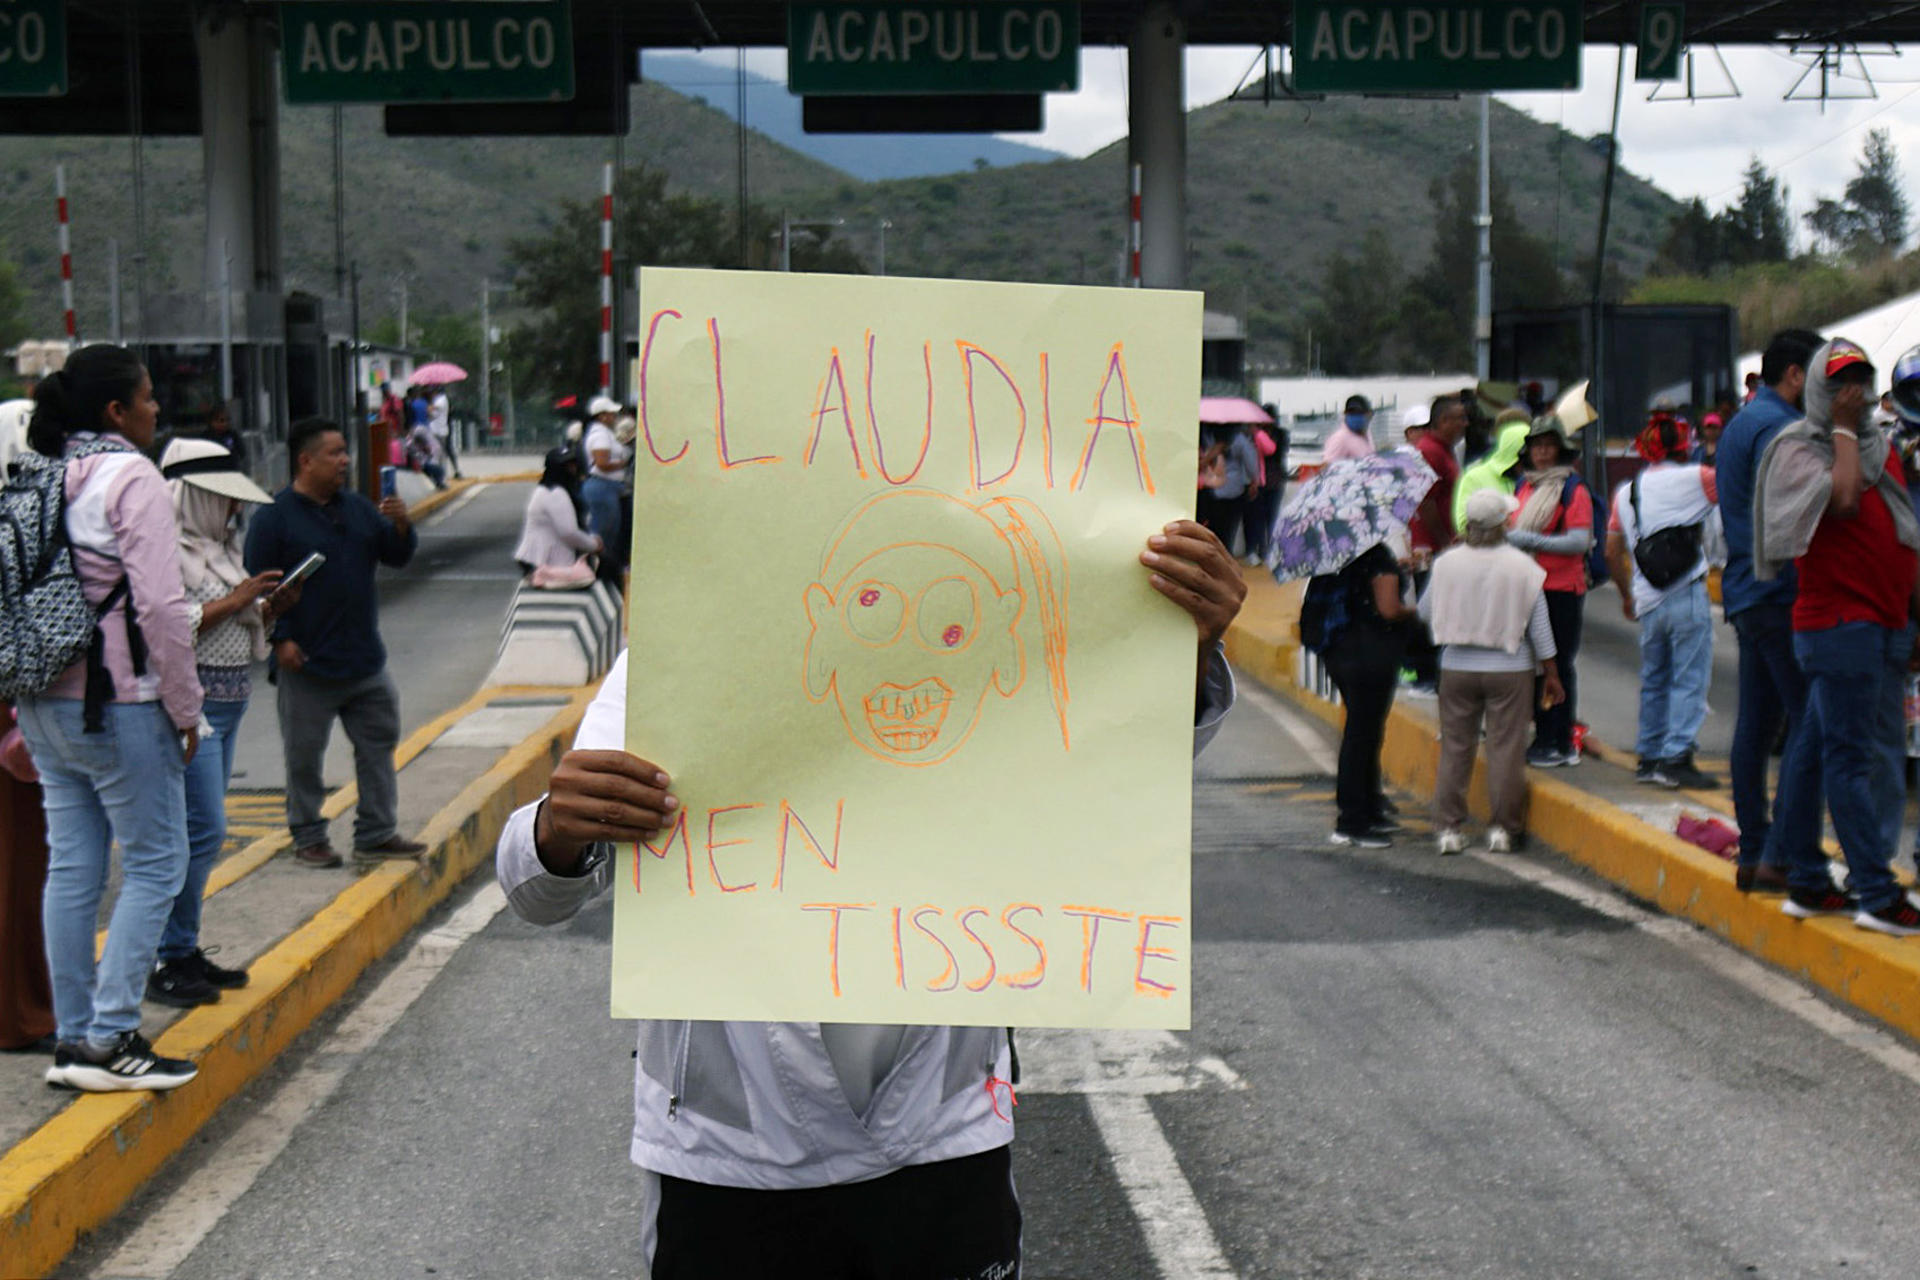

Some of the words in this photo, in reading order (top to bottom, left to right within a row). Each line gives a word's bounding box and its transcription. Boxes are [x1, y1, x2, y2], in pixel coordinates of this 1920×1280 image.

[300, 18, 555, 72] ACAPULCO
[807, 9, 1063, 62] ACAPULCO
[1311, 9, 1566, 61] ACAPULCO
[1647, 10, 1676, 71] 9
[640, 309, 1156, 496] CLAUDIA
[631, 798, 846, 896] MEN
[800, 902, 1183, 998] TISSSTE
